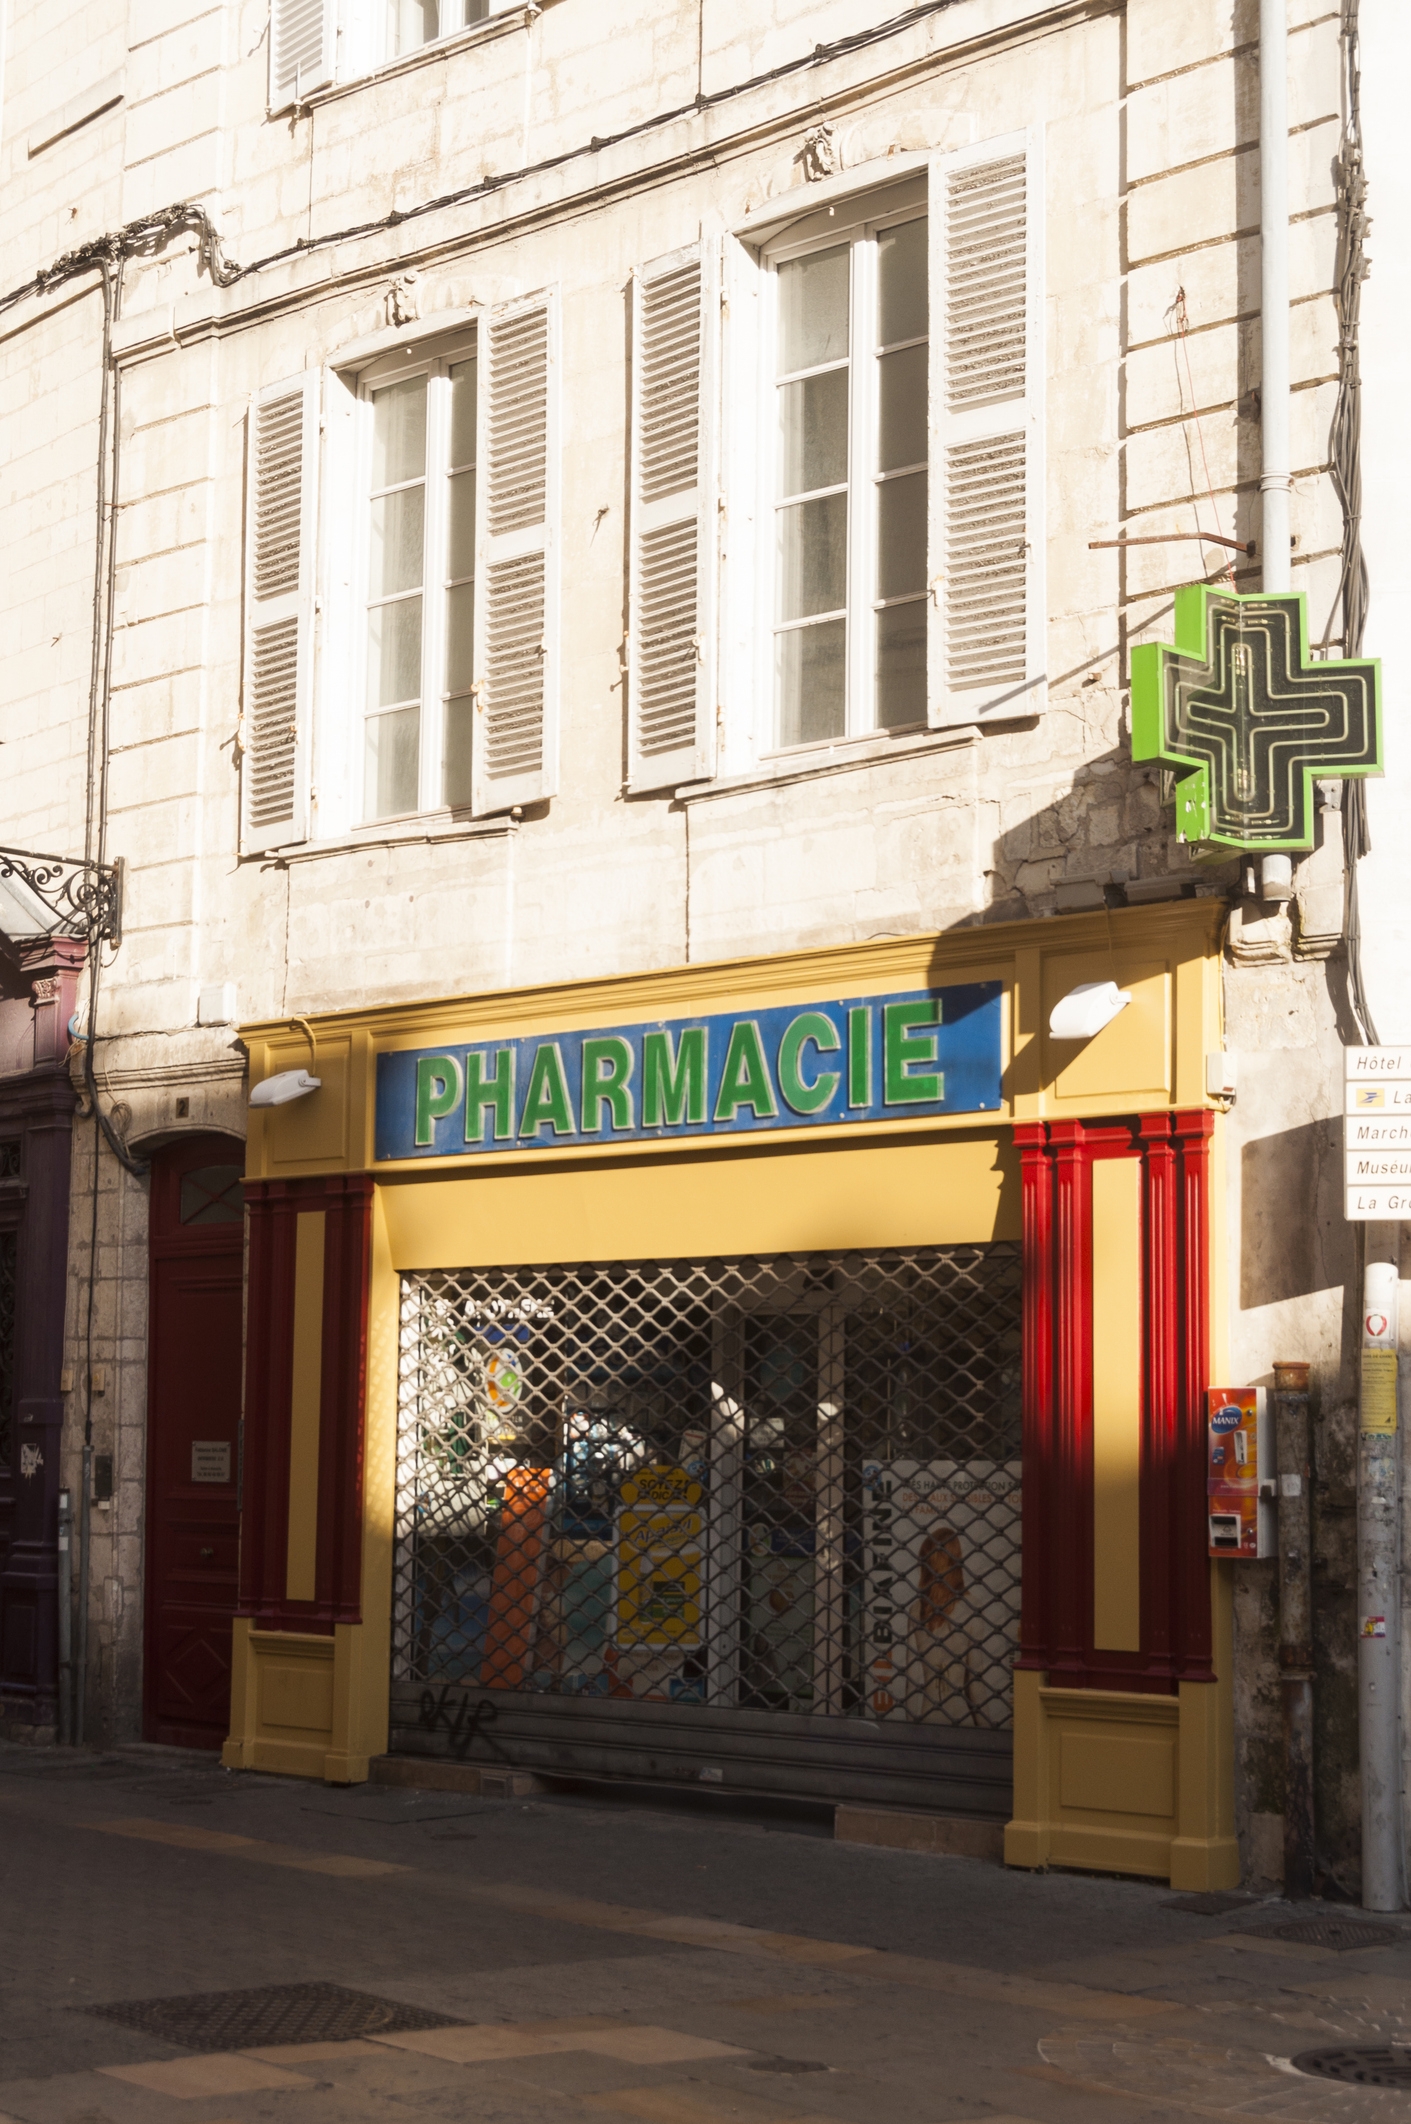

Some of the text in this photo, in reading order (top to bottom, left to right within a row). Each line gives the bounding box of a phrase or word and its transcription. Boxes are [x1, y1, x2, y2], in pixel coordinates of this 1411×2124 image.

[1356, 1055, 1401, 1070] Hôtel
[414, 998, 945, 1146] PHARMACIE
[1393, 1090, 1411, 1104] La
[178, 1099, 186, 1116] 2
[1356, 1126, 1411, 1140] March
[1356, 1160, 1411, 1175] Muséu
[1357, 1196, 1377, 1210] La
[1212, 1416, 1239, 1425] MANIX
